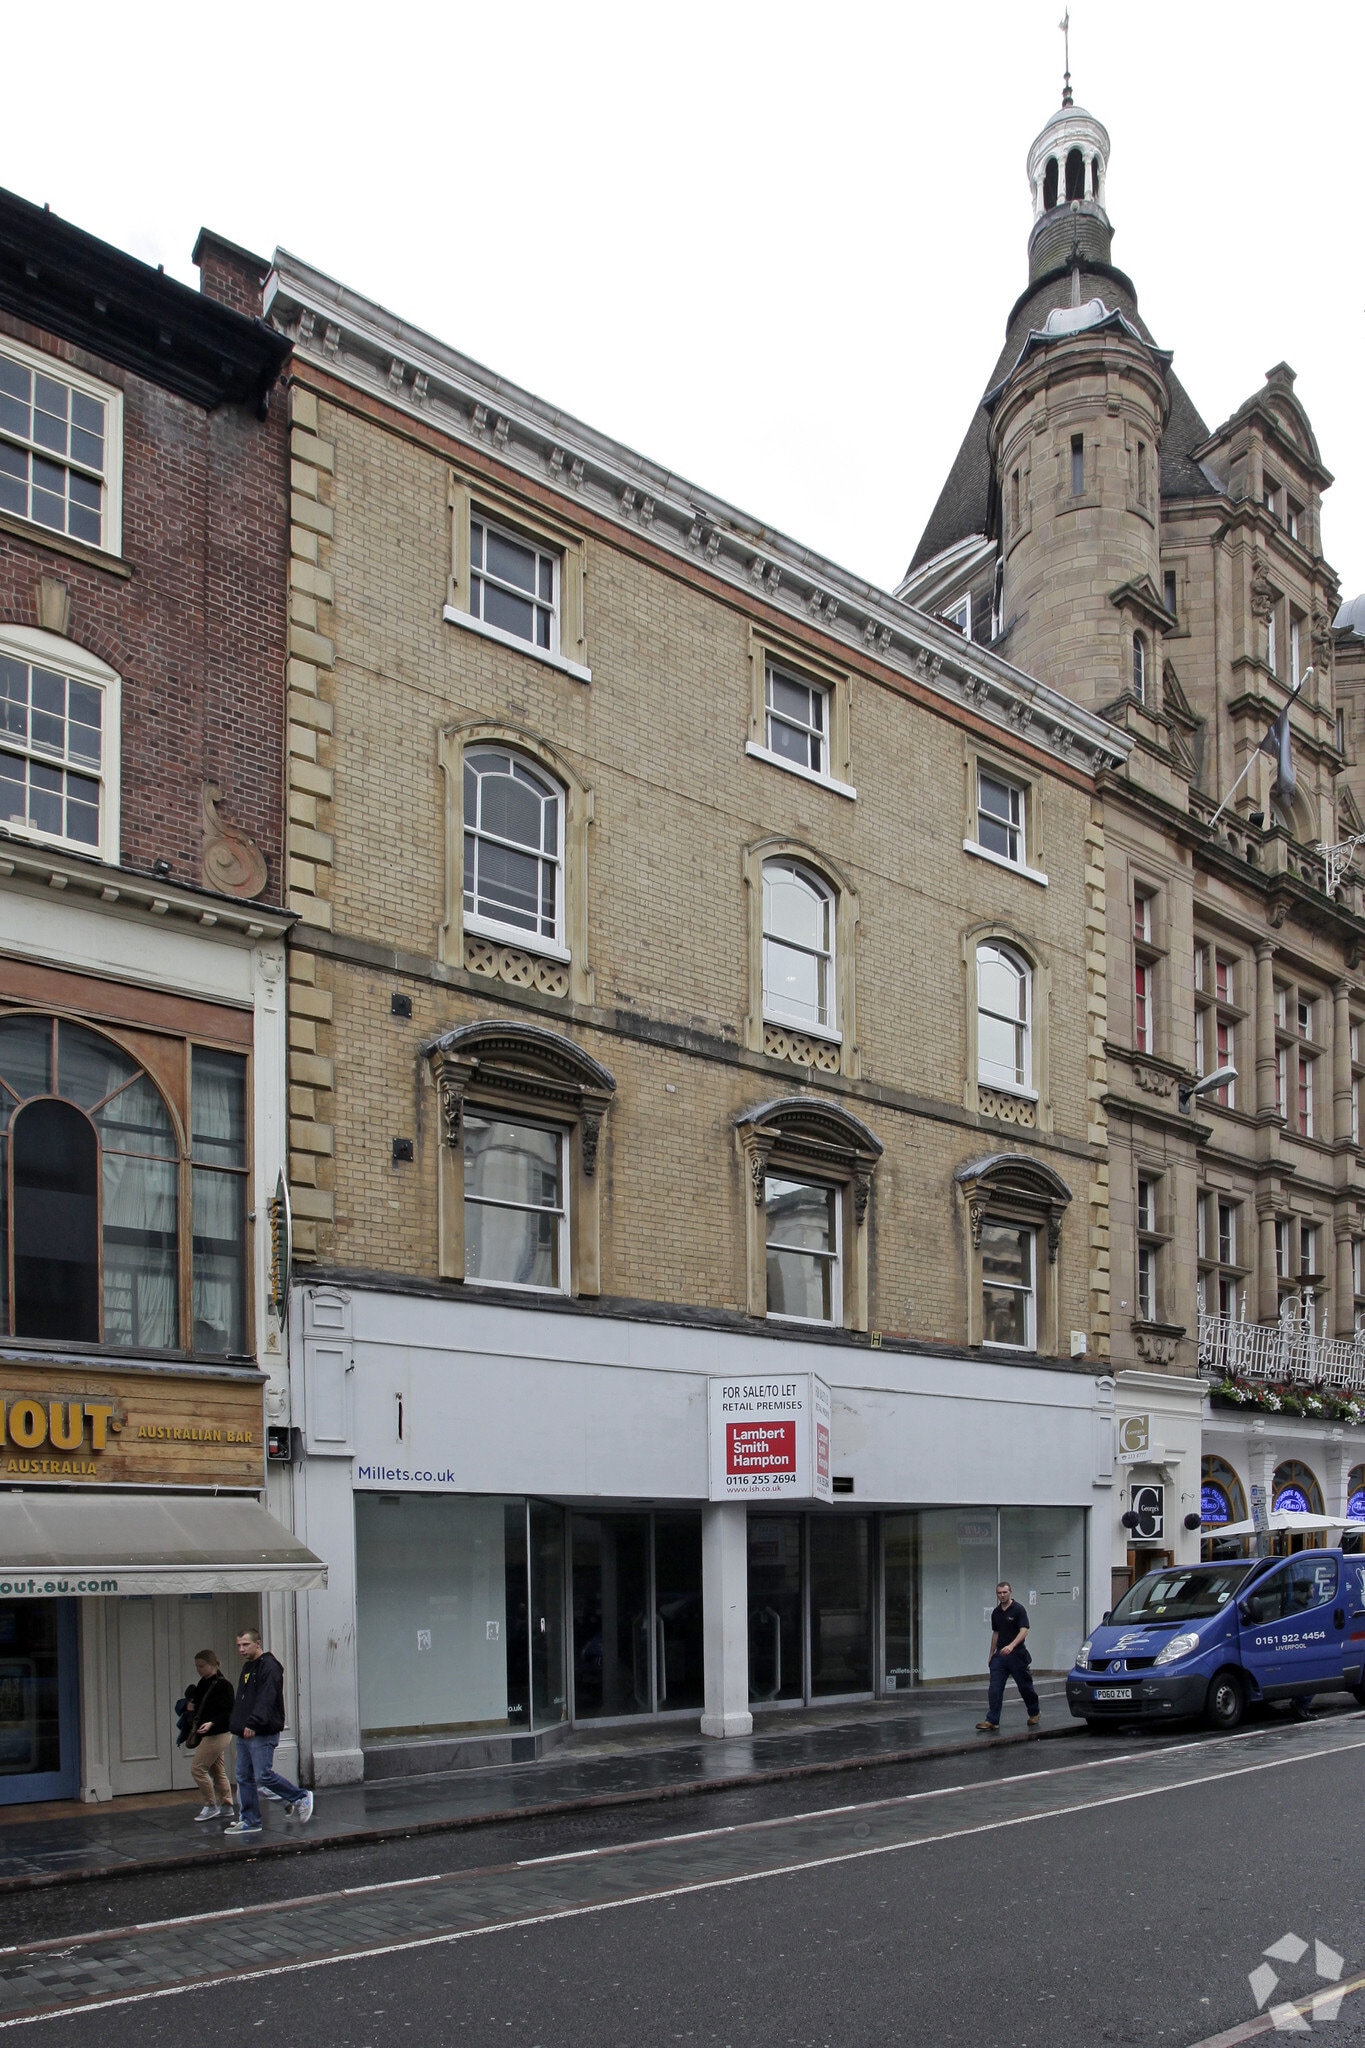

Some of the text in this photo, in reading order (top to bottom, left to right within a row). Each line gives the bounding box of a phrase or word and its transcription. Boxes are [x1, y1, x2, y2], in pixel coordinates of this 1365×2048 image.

[723, 1385, 796, 1398] FOR SALE/TO LET
[723, 1401, 802, 1411] RETAIL PREMISES
[0, 1399, 114, 1450] OUT
[138, 1426, 253, 1442] AUSTRALIAN BAR
[733, 1427, 785, 1440] Lambert
[733, 1441, 769, 1454] Smith
[7, 1459, 97, 1474] AUSTRALIA
[734, 1455, 789, 1467] Hampton
[358, 1466, 455, 1482] Millets.co.uk
[726, 1474, 796, 1485] 0116 255 2694
[727, 1485, 781, 1493] www.lsh.co.uk
[1141, 1504, 1159, 1513] George's
[1256, 1631, 1326, 1645] 0151 922 4454
[1275, 1643, 1306, 1651] LIVERPOOL
[1117, 1689, 1131, 1698] ZYC
